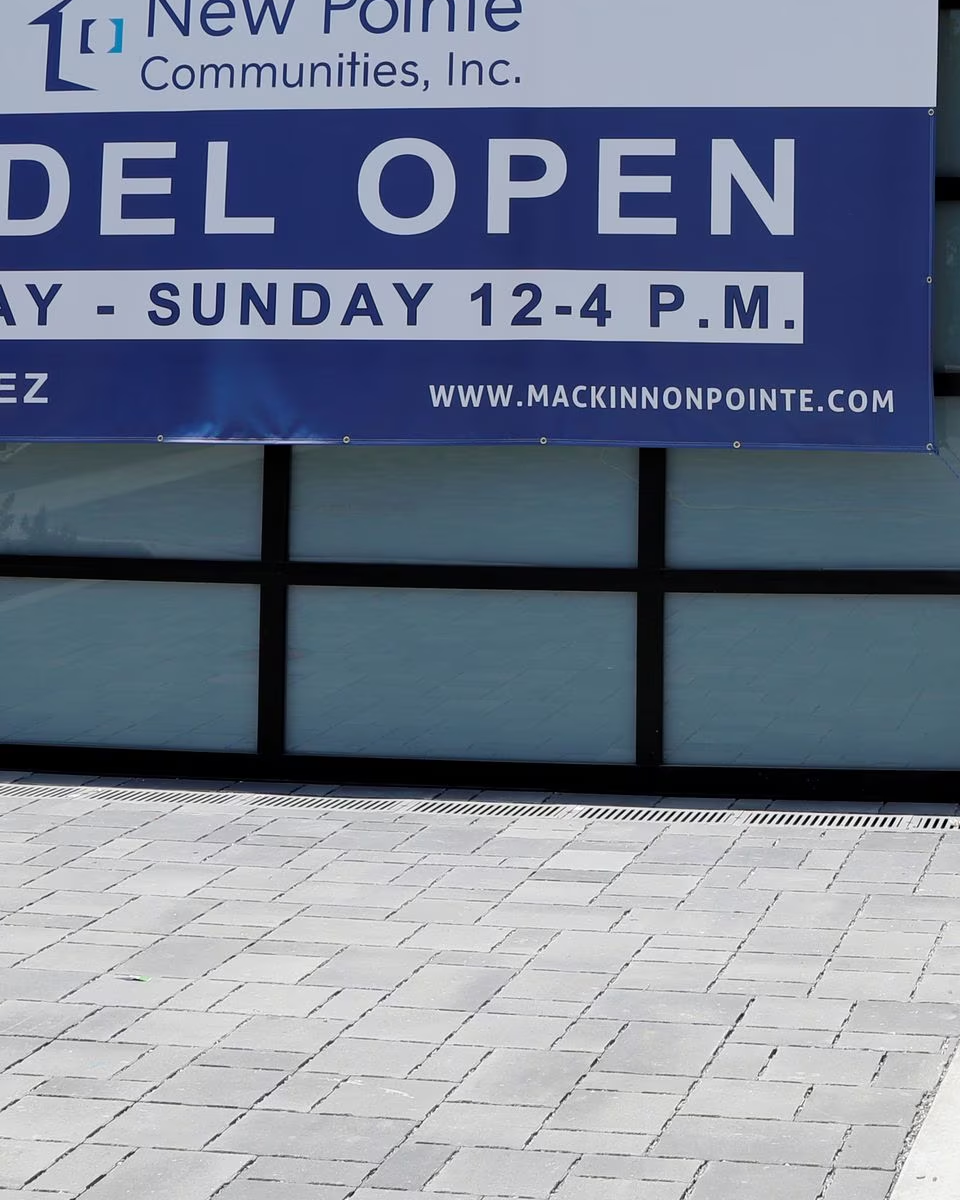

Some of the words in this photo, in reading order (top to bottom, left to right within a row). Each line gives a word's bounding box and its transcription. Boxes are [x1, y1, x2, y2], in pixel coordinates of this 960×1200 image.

[141, 52, 430, 92] Communities,
[449, 52, 521, 87] Inc.
[358, 138, 795, 236] OPEN
[148, 282, 434, 327] SUNDAY
[470, 282, 612, 328] 12-4
[649, 283, 796, 330] P.M.
[429, 384, 895, 413] WWW.MACKINNONPOINTE.COM
